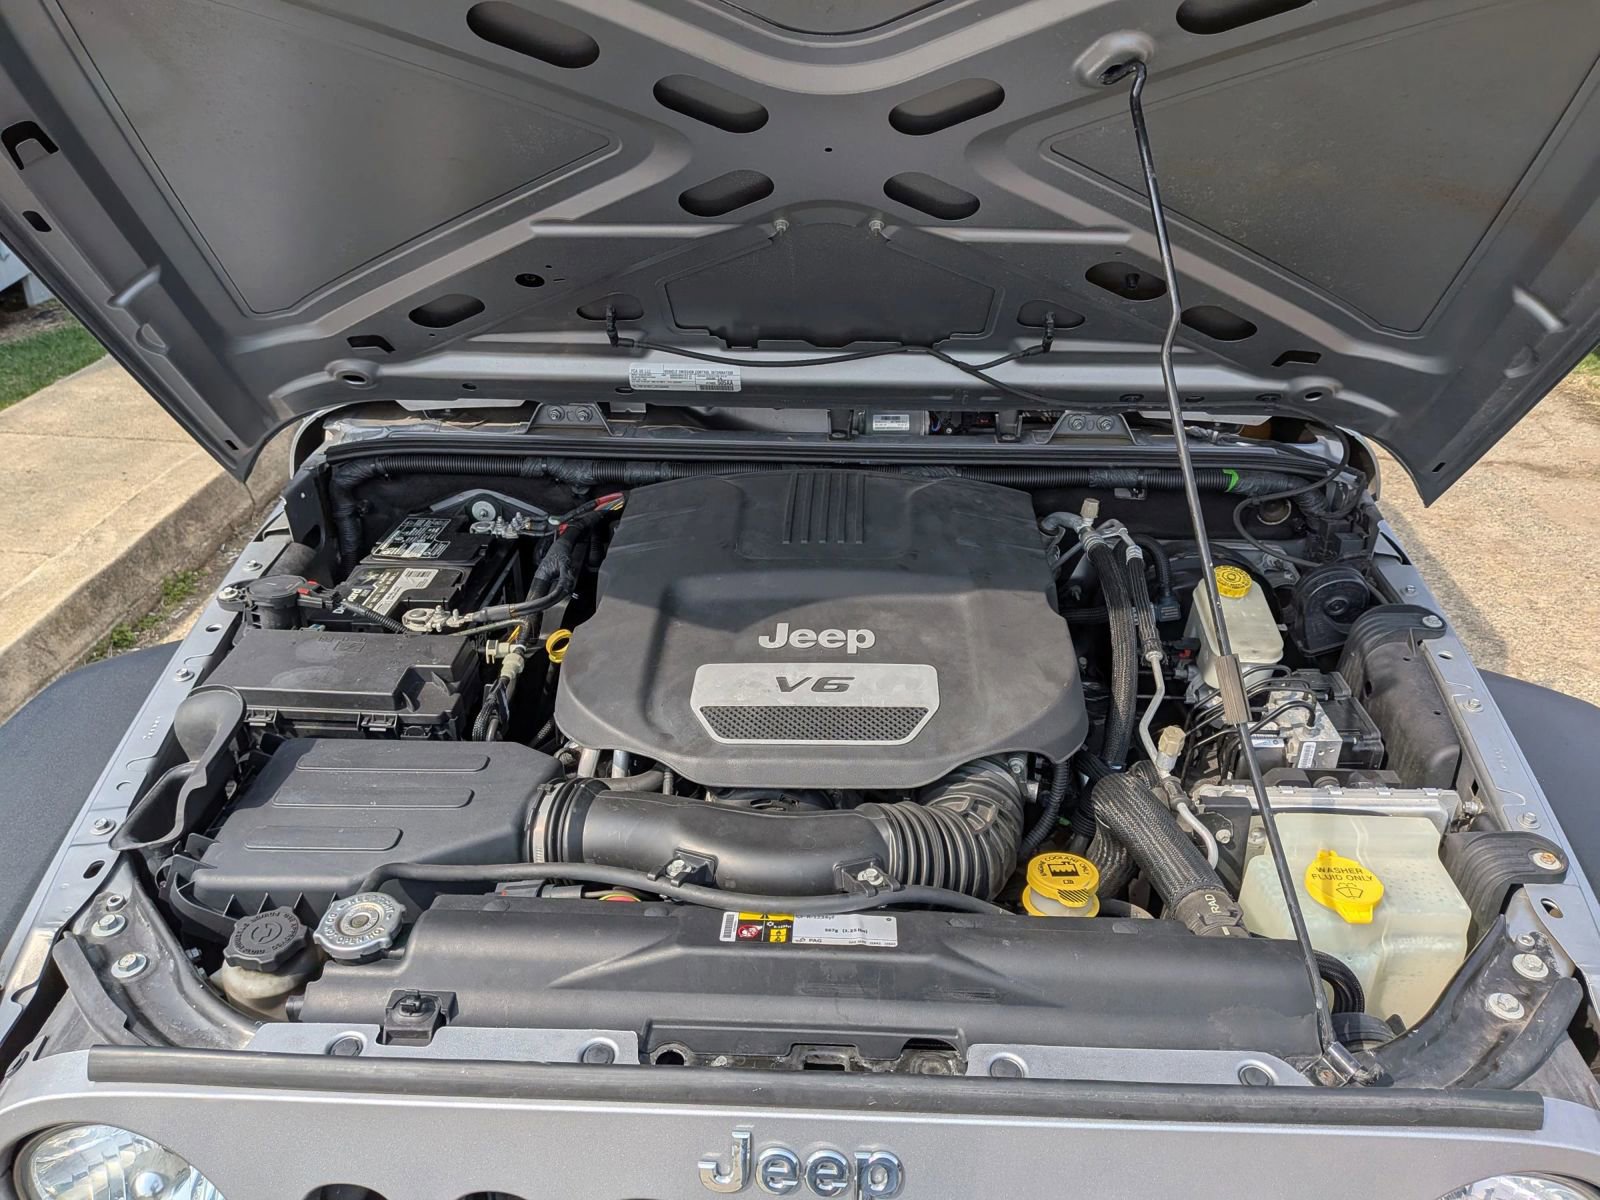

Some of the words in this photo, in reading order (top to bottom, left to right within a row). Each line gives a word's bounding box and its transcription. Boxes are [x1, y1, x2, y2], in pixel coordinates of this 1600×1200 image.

[758, 622, 875, 654] Jeep
[775, 676, 856, 692] V6
[1311, 873, 1343, 881] FLUID
[1346, 874, 1373, 882] ONLY
[1204, 893, 1222, 914] RAD
[336, 936, 365, 945] OPEN
[698, 1130, 903, 1200] Jeep
